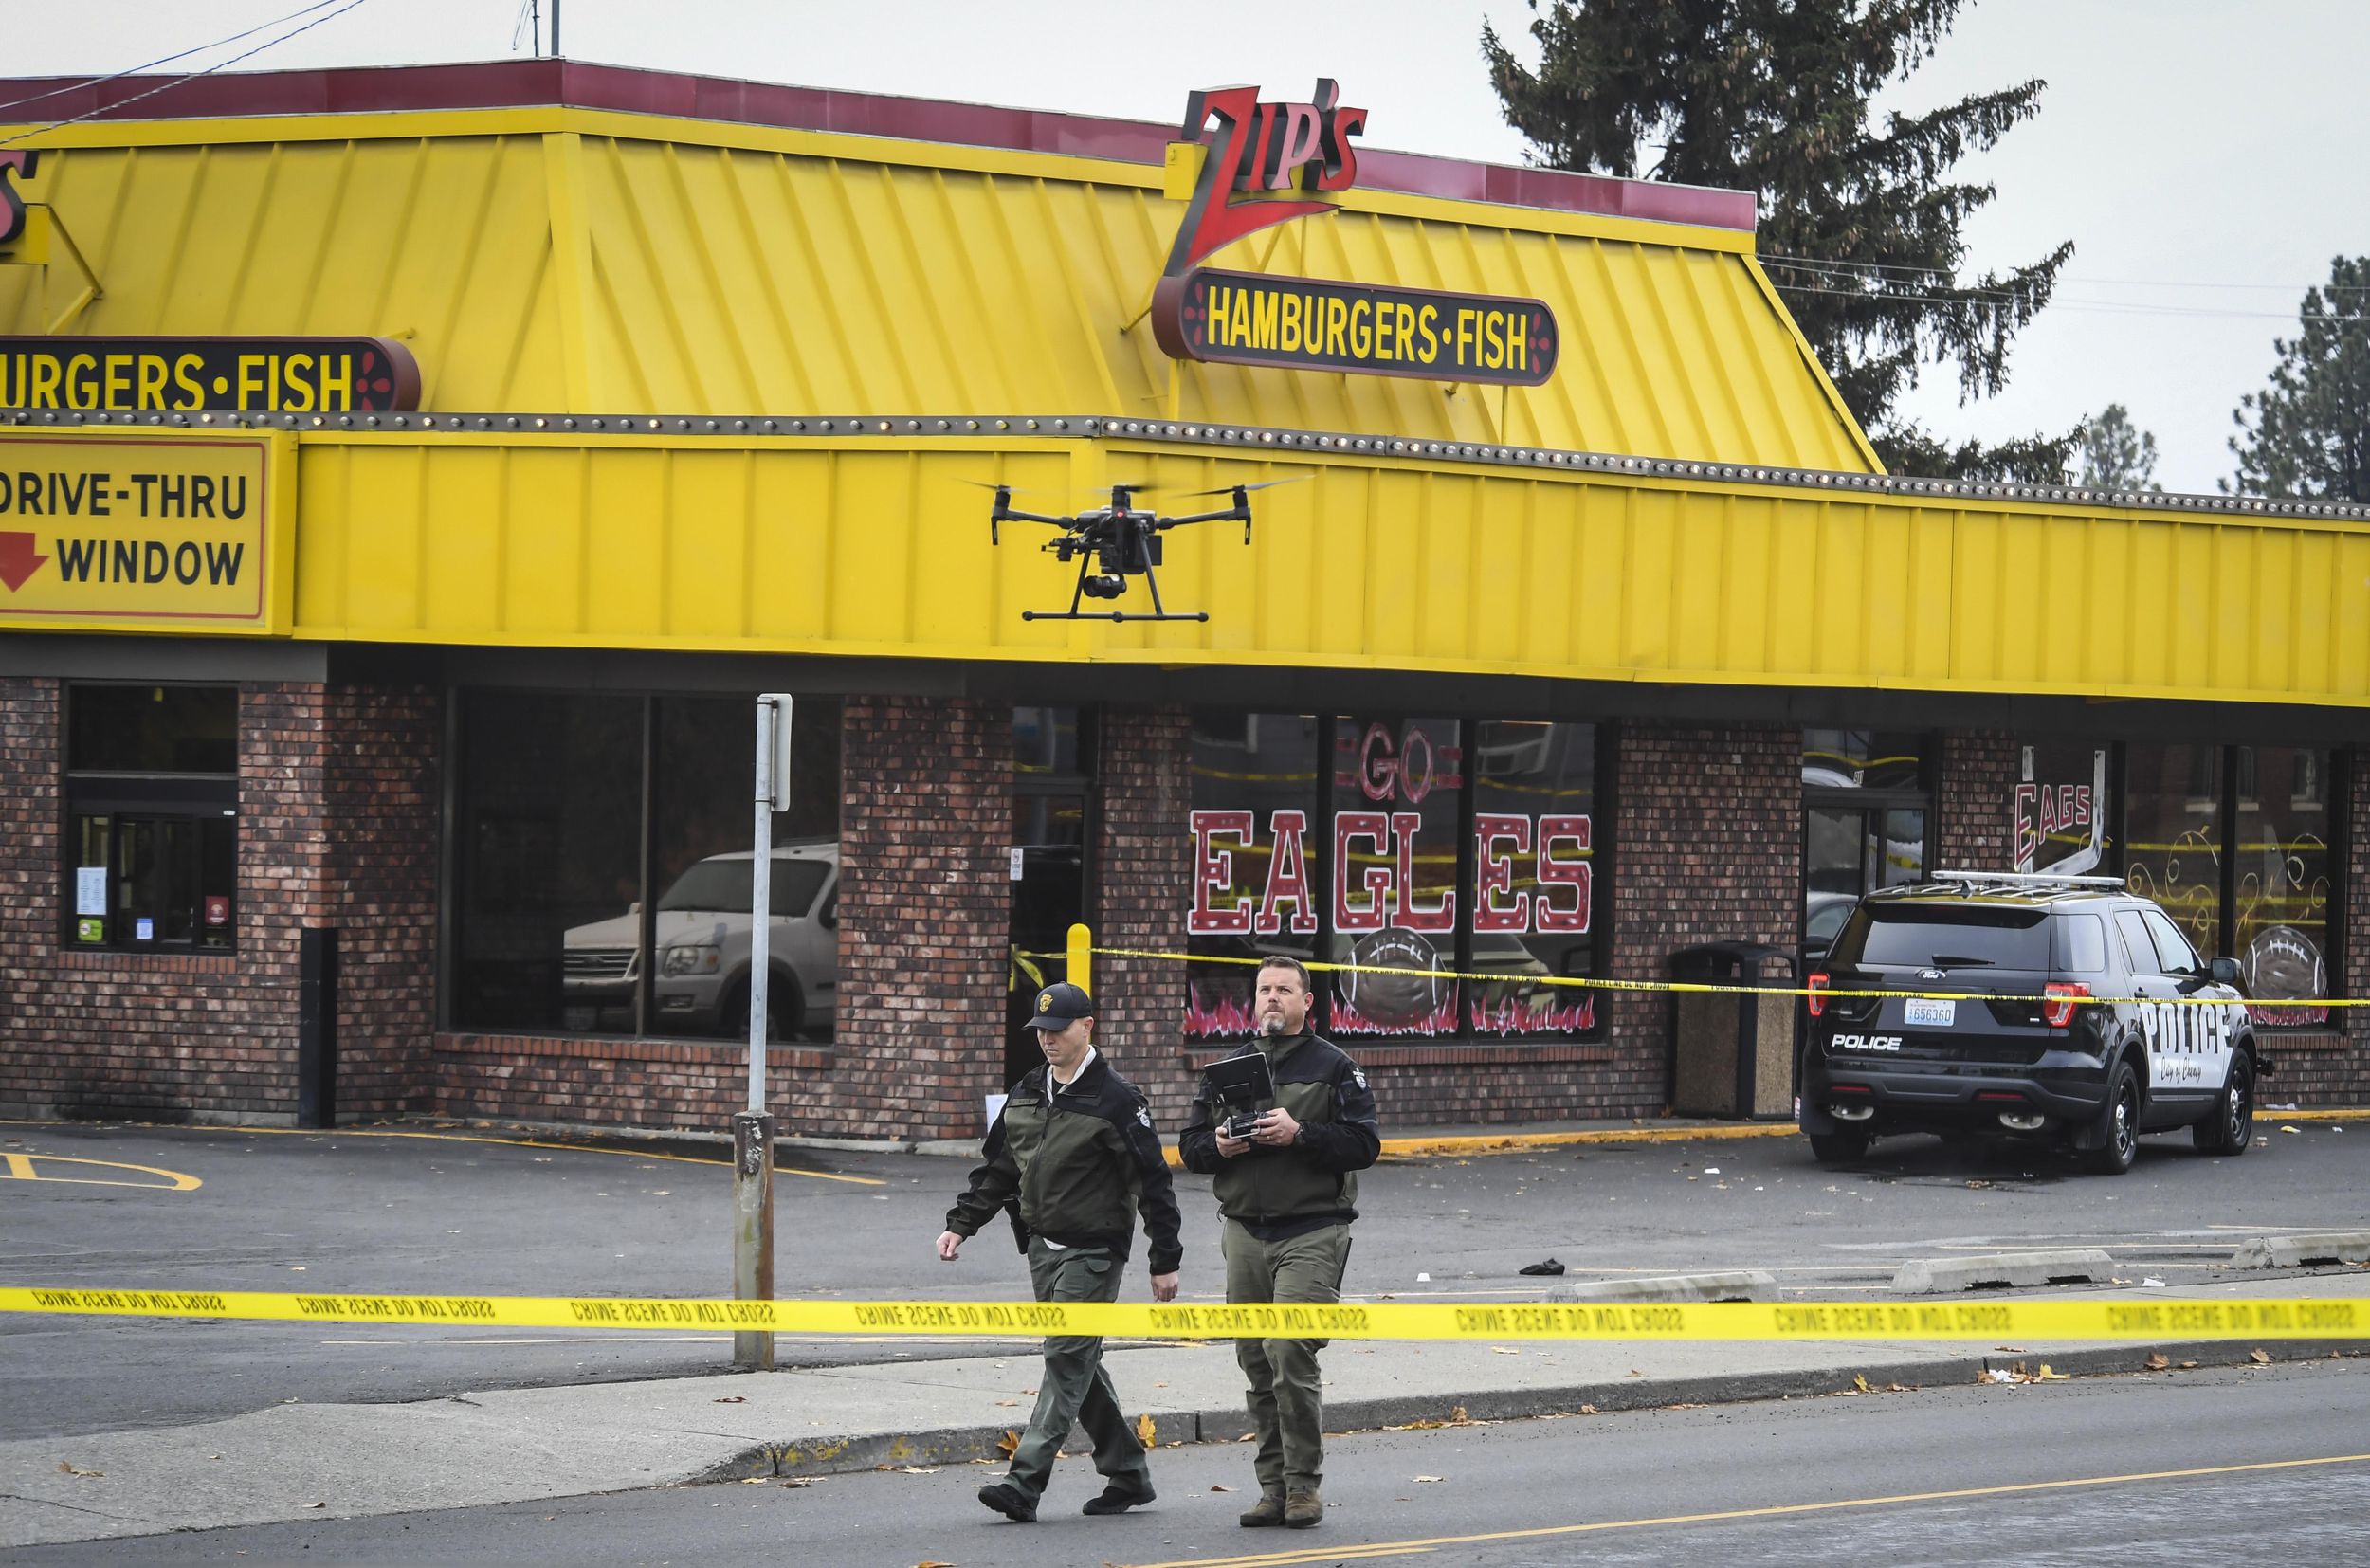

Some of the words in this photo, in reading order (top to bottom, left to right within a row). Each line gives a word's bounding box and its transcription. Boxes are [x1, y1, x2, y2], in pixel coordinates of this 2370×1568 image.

[56, 538, 245, 586] WINDOW
[1359, 721, 1433, 804] GO
[2014, 784, 2091, 873] EAGS
[1187, 810, 1593, 934] EAGLES
[1831, 1034, 1903, 1051] POLICE
[2140, 1002, 2233, 1054] POLICE
